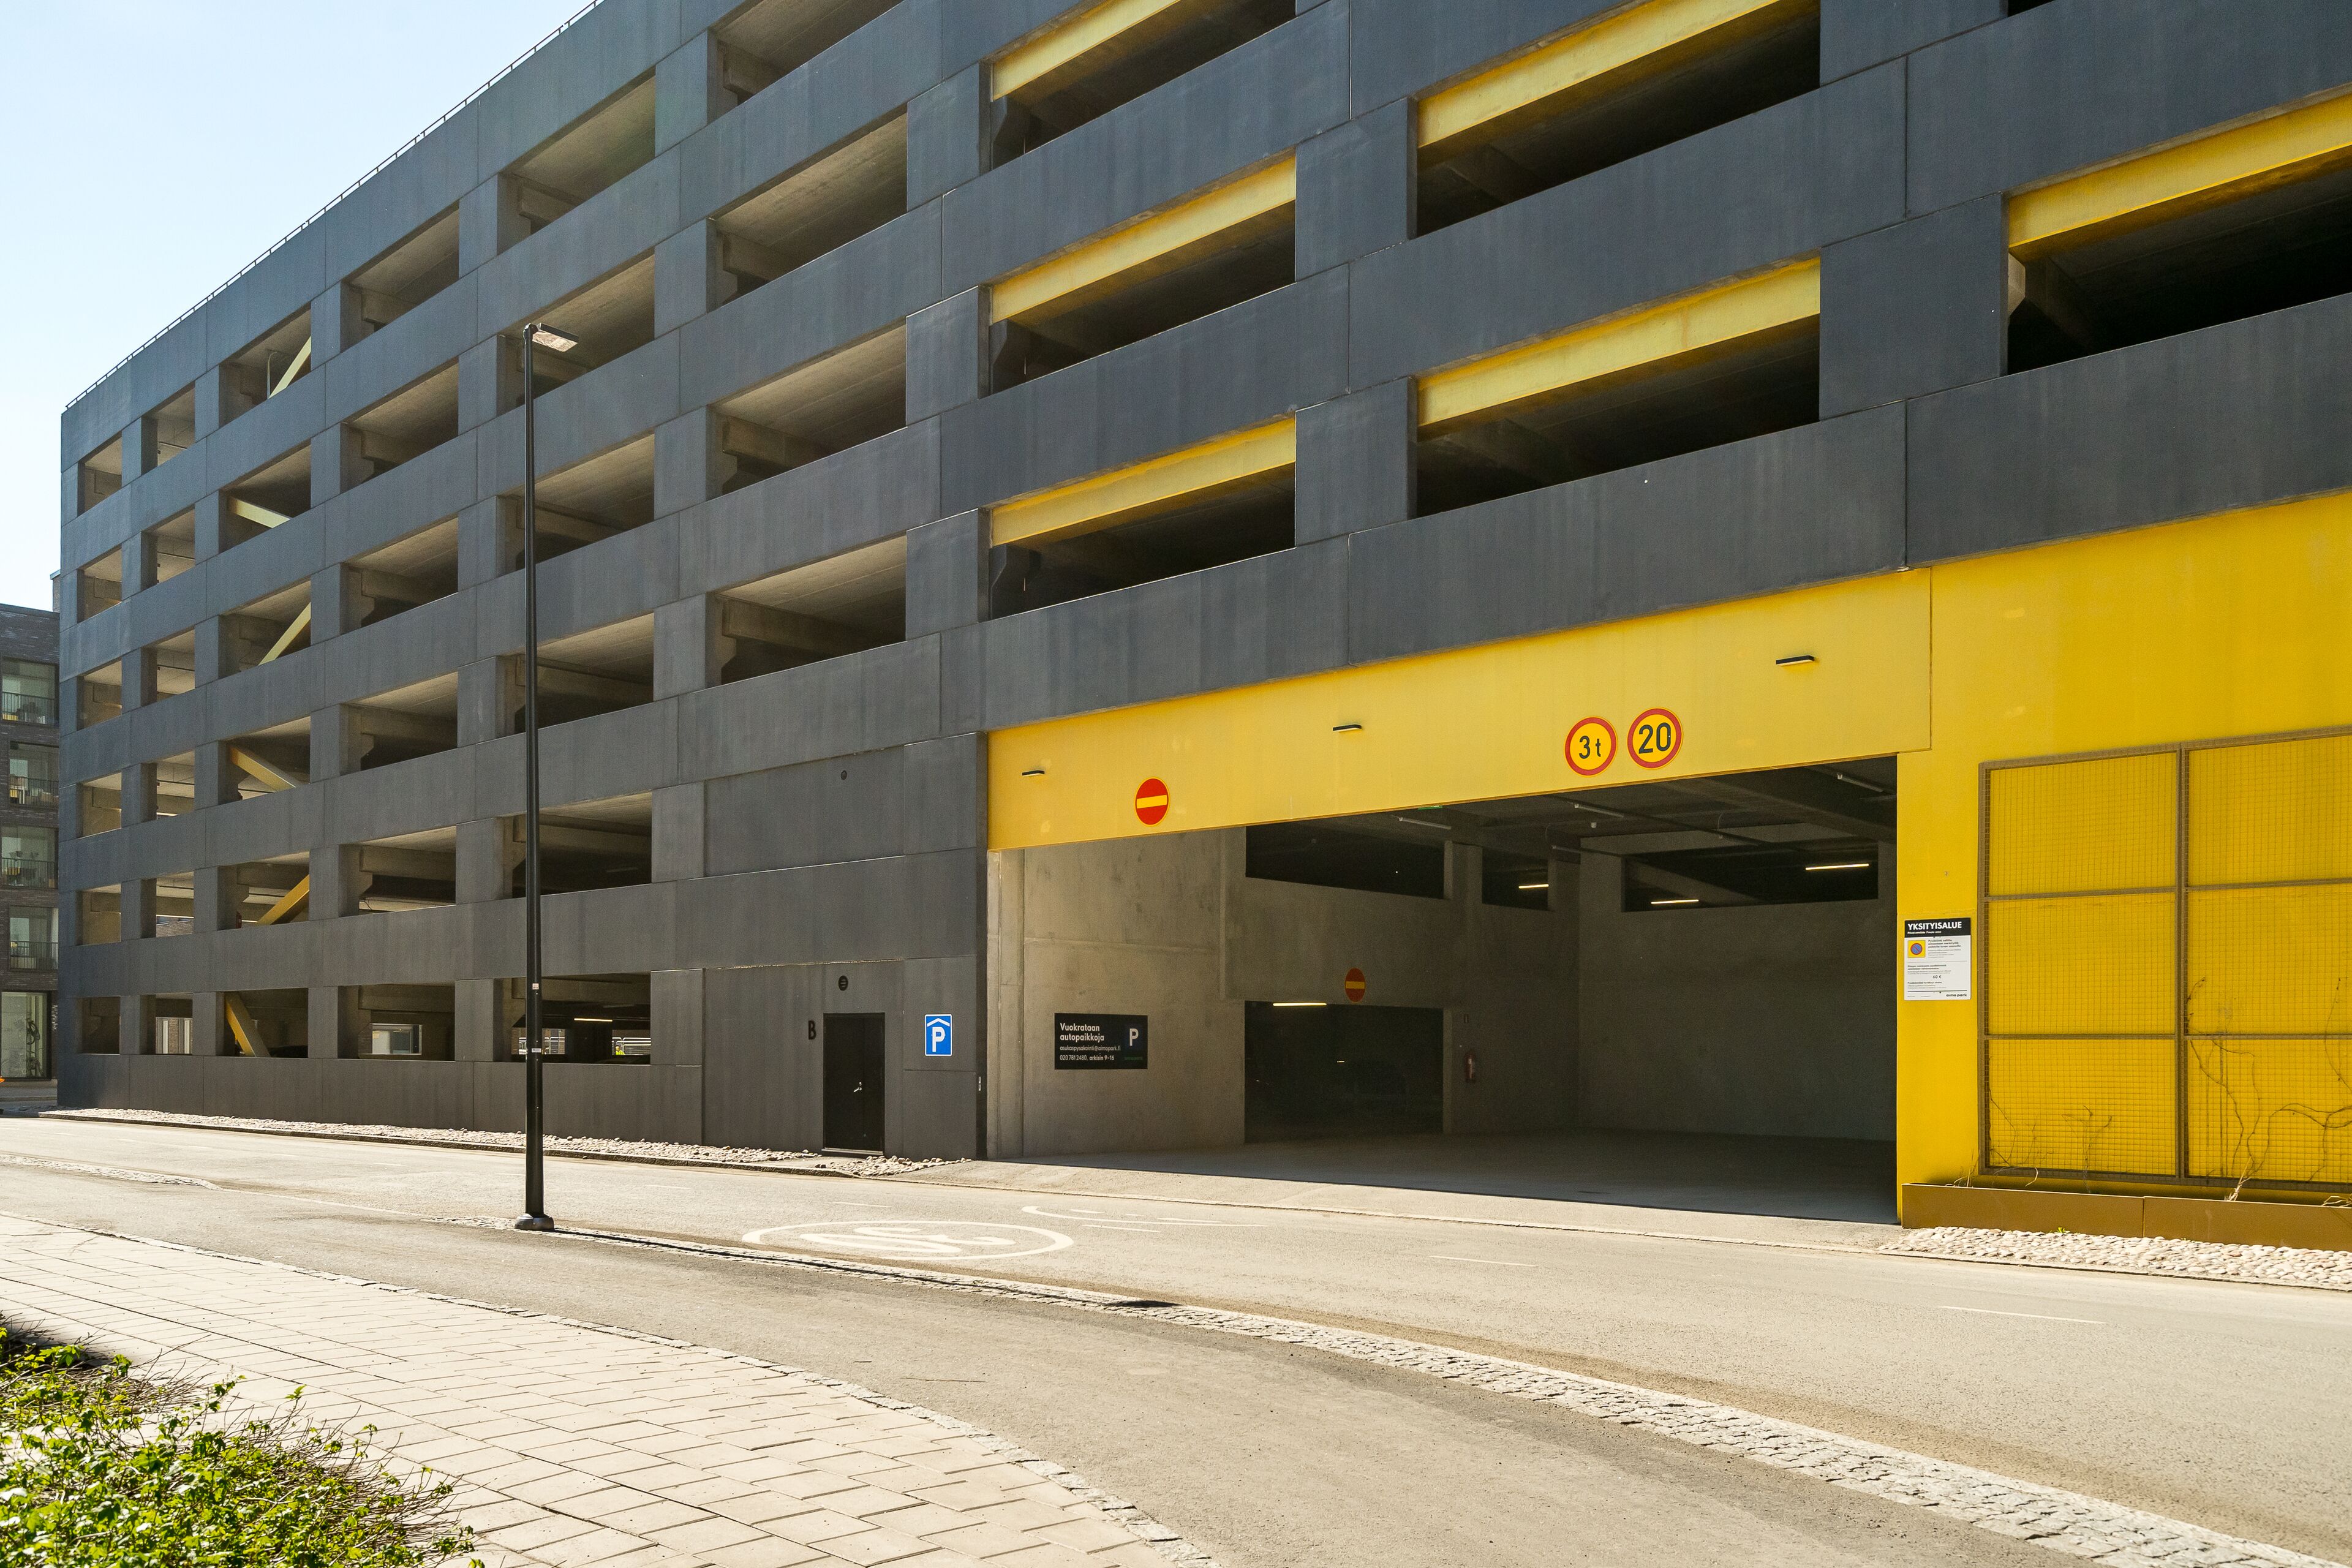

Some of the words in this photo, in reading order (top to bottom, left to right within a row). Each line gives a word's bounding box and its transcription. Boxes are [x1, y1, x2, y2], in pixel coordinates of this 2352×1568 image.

[1579, 736, 1590, 759] 3
[1595, 738, 1601, 757] t
[1638, 722, 1671, 754] 20
[1907, 921, 1962, 930] YKSITYISALUE
[809, 1020, 816, 1040] B
[1060, 1023, 1100, 1031] Vuokrataan
[932, 1027, 945, 1052] P
[1060, 1033, 1104, 1042] autopaikkoja
[1129, 1028, 1139, 1046] P
